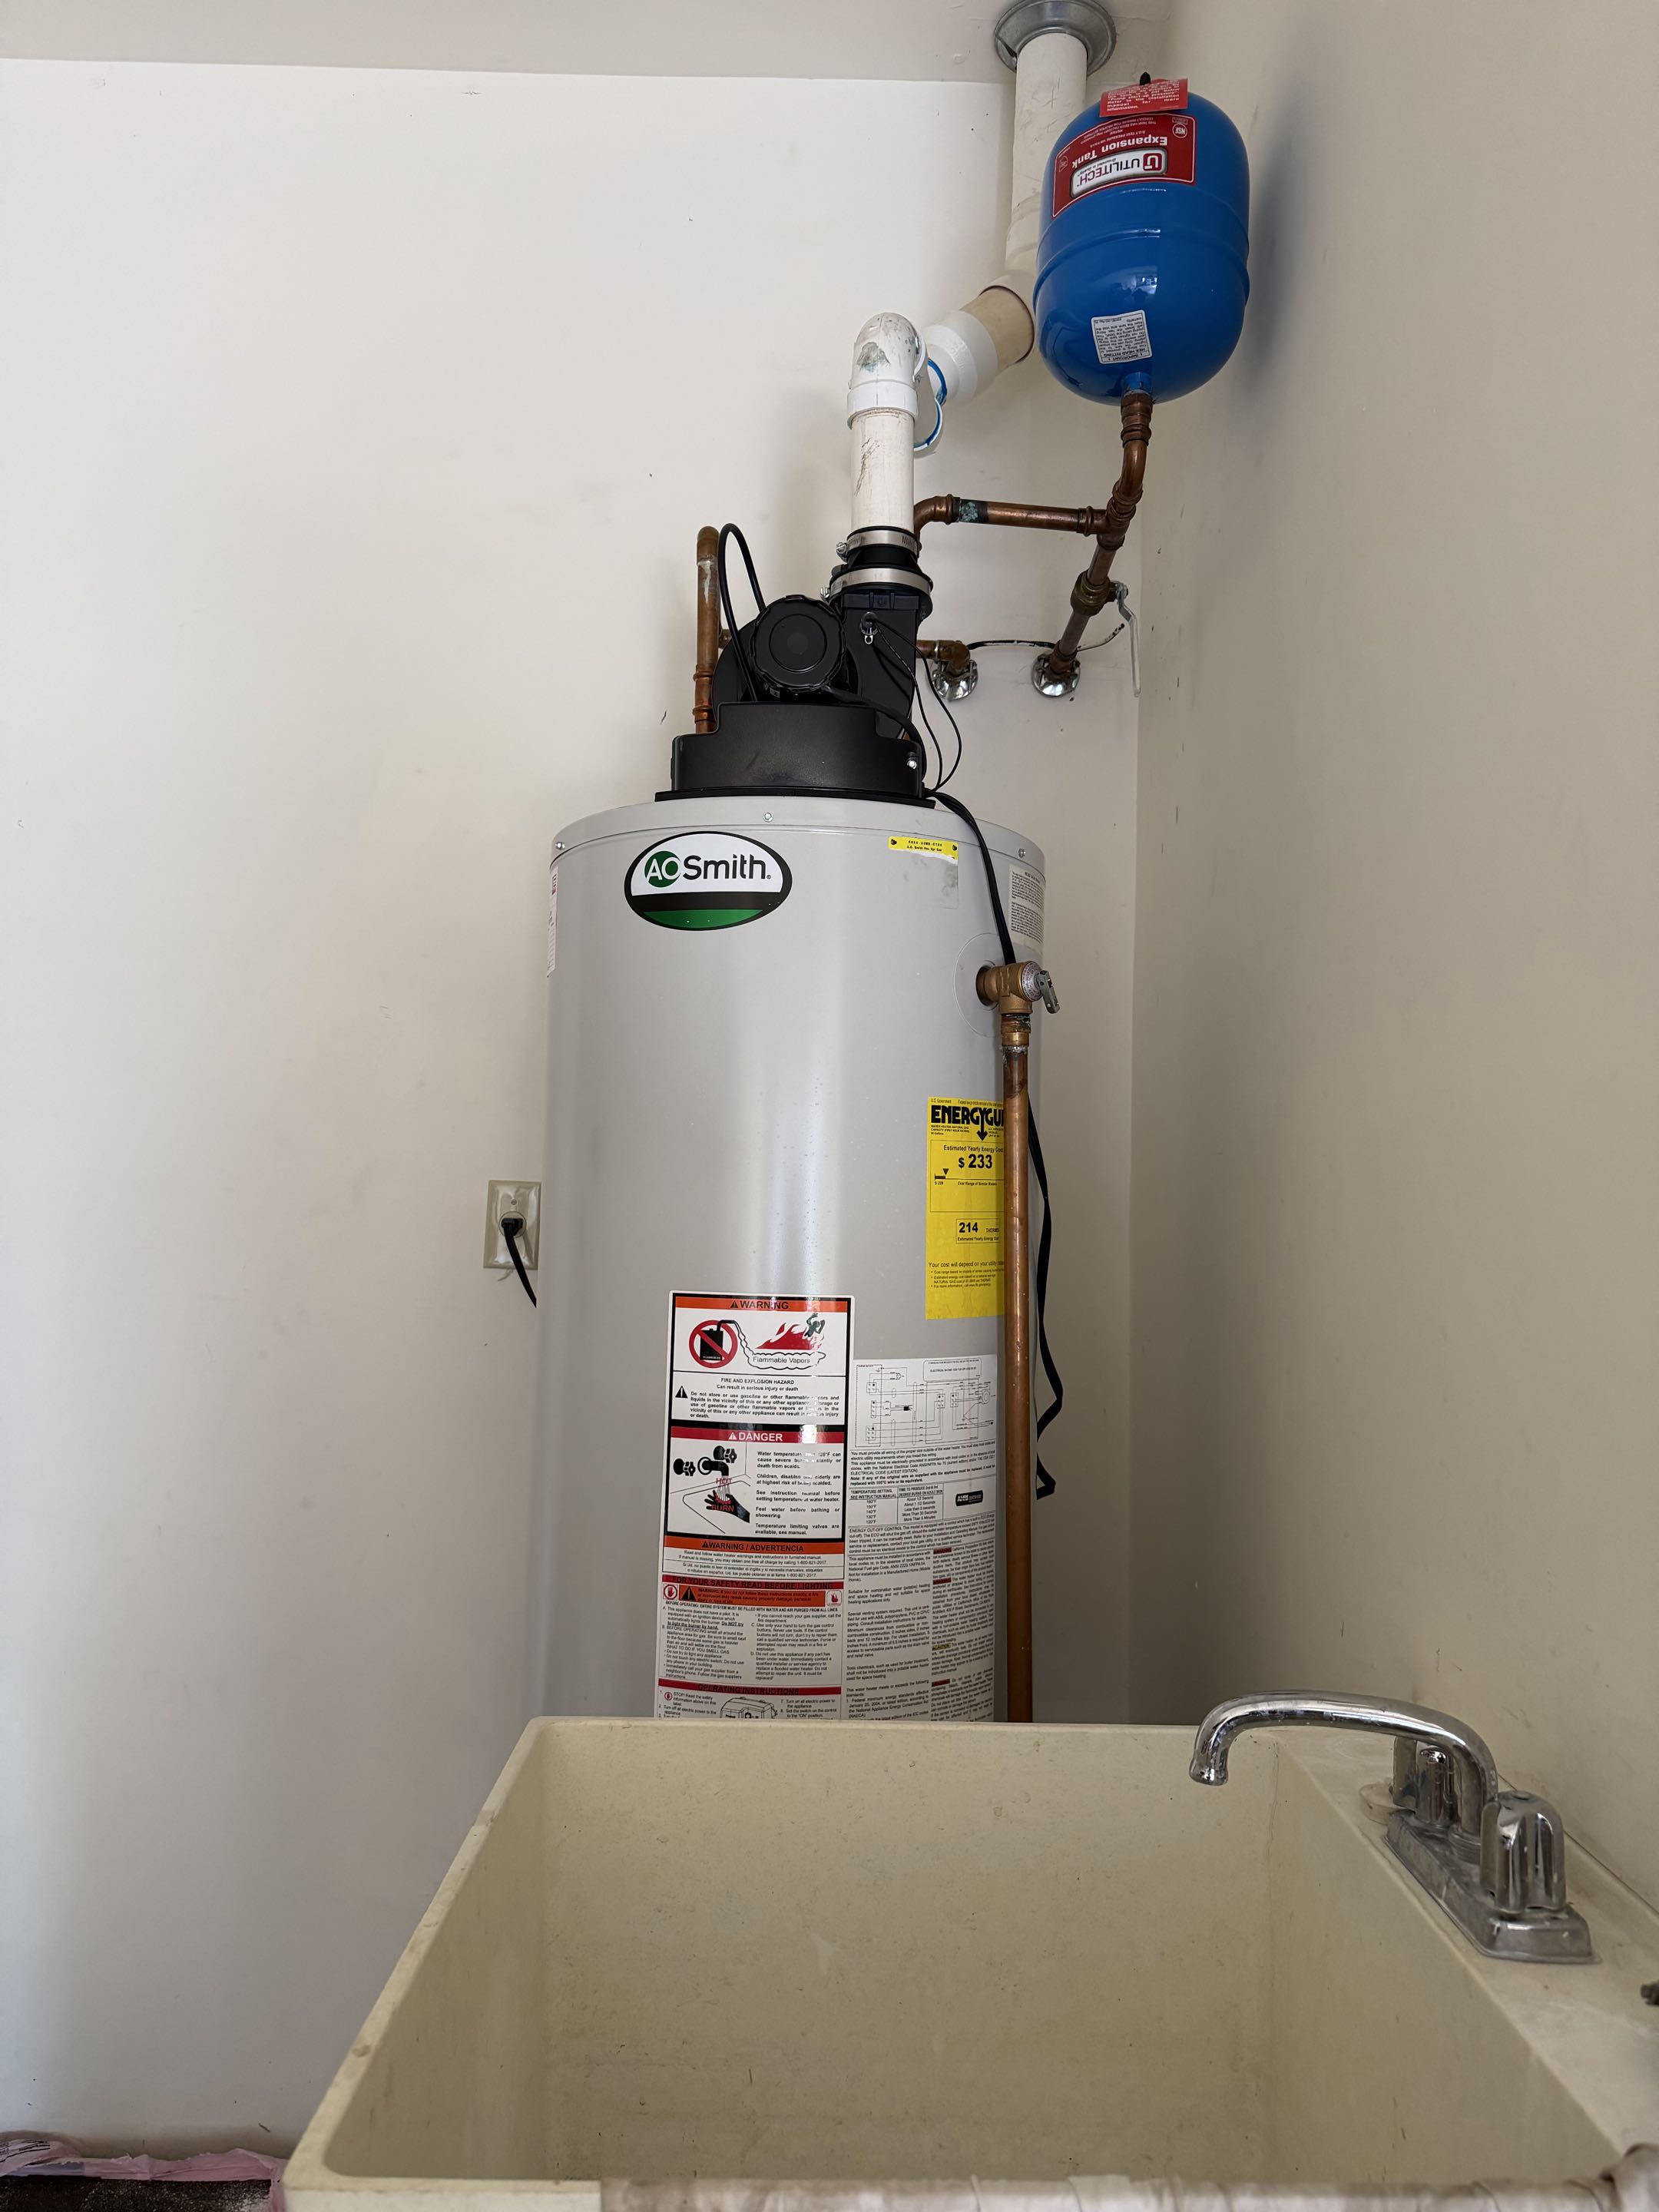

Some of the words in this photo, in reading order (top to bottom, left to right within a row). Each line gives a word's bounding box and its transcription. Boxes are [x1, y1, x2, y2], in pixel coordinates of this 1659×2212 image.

[1174, 127, 1186, 136] NSF
[1101, 134, 1168, 153] Expansion
[1071, 150, 1098, 169] Tank
[931, 1104, 1004, 1127] ENERGYGUI
[959, 1157, 965, 1169] $
[968, 1154, 992, 1169] 233
[959, 1222, 979, 1233] 214
[740, 1300, 789, 1310] WARNNG
[738, 1432, 783, 1442] DANGER
[711, 1504, 734, 1512] BURN
[697, 1684, 741, 1694] OPERATING
[743, 1686, 800, 1695] INSTRUCTIONS
